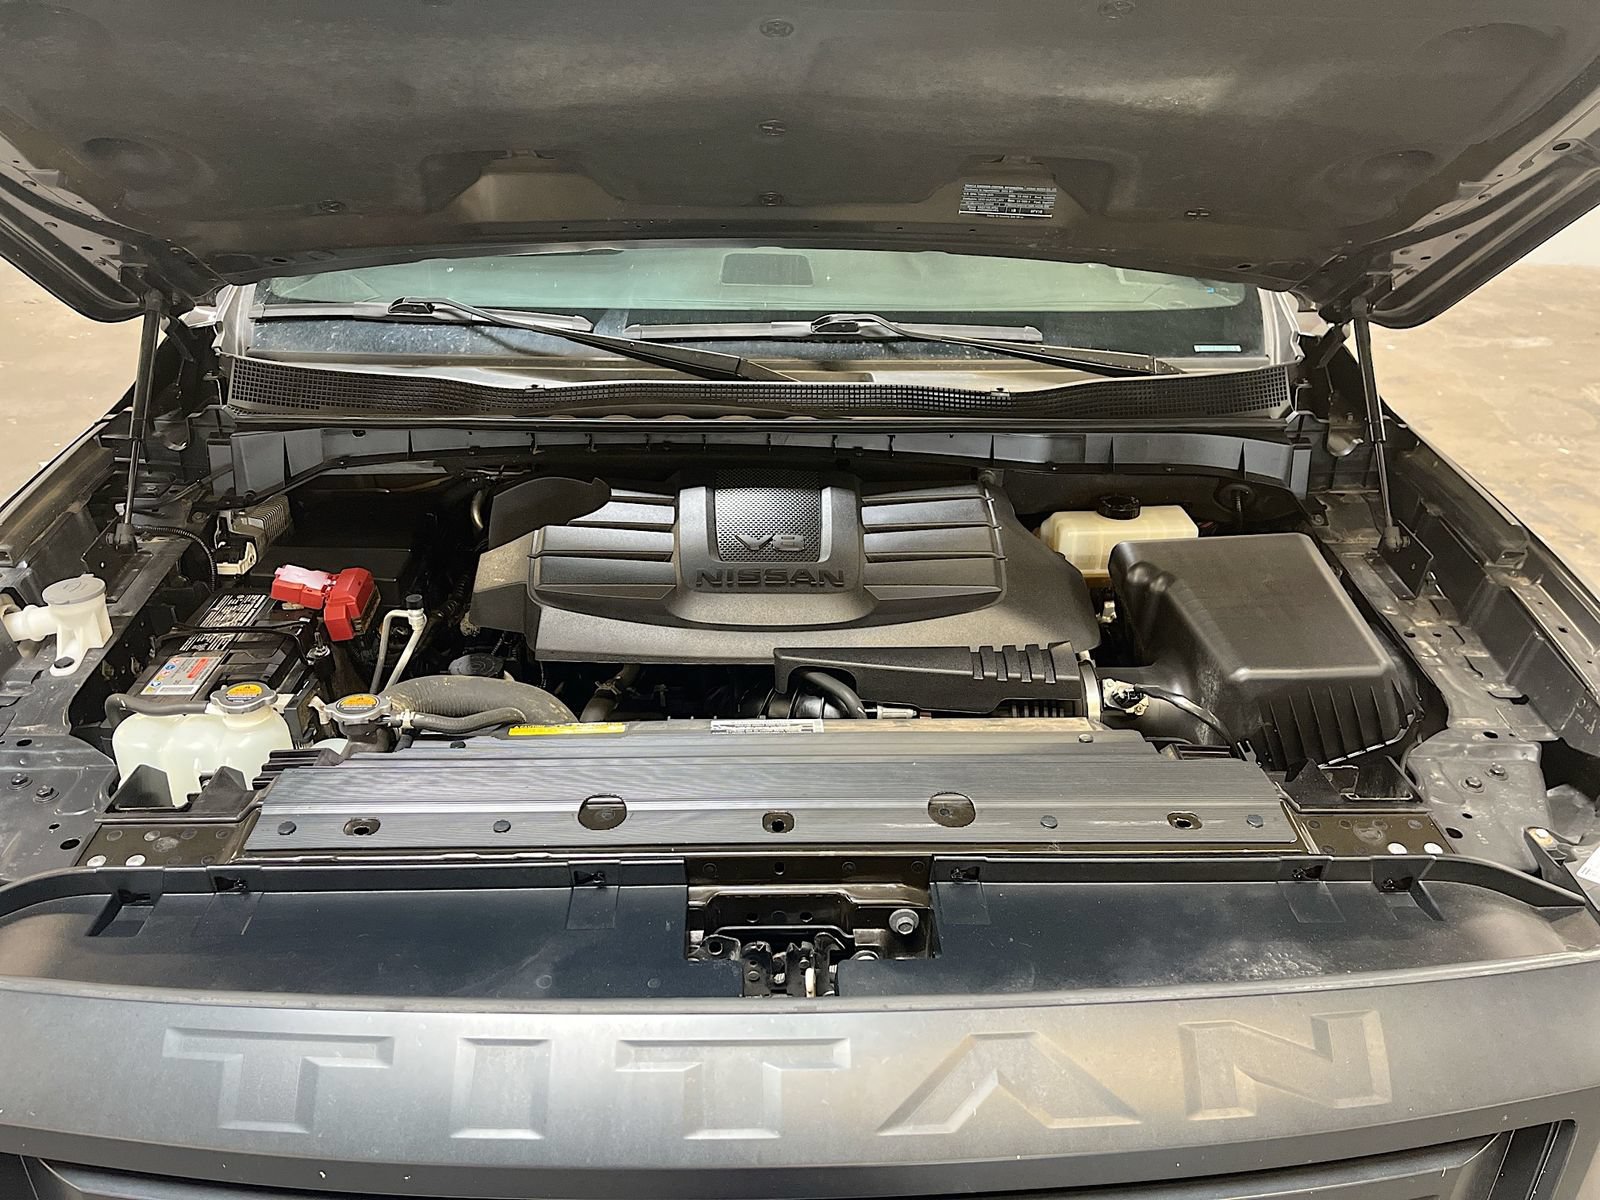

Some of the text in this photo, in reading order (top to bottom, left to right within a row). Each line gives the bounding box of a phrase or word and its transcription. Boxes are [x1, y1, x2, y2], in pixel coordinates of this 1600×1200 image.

[734, 534, 805, 552] V8
[696, 568, 845, 588] NISSAN
[162, 1010, 1392, 1139] TITAN
